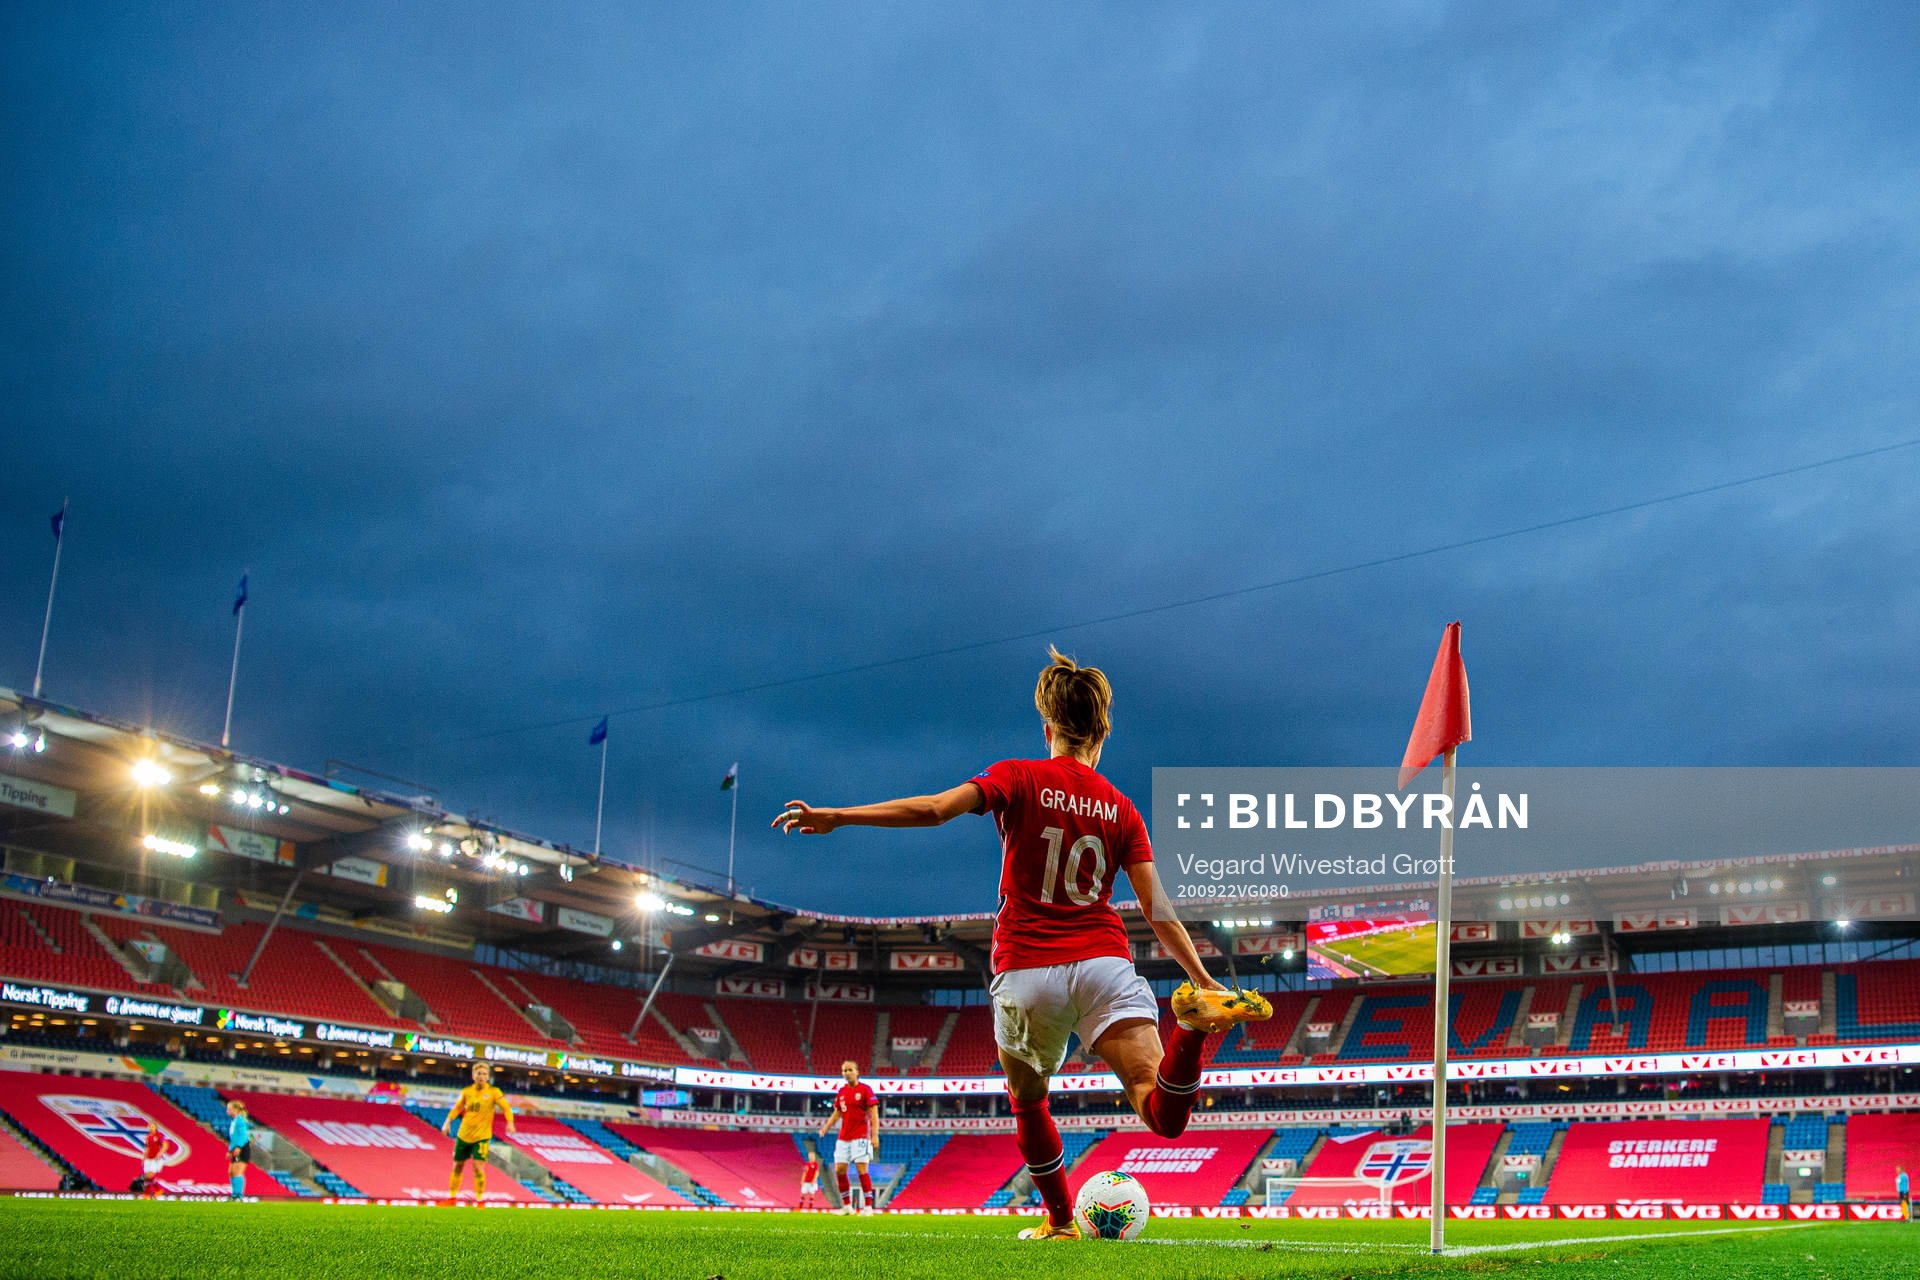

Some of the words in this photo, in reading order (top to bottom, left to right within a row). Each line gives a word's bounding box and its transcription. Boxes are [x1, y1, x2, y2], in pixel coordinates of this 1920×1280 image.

[1040, 787, 1118, 824] GRAHAM
[1040, 825, 1107, 907] 10
[1727, 903, 1801, 924] VG
[1830, 896, 1906, 917] VG
[1524, 918, 1594, 937] VG
[1621, 910, 1690, 930] VG
[702, 942, 758, 960] VG
[1238, 935, 1299, 953] VG
[897, 953, 959, 968] VG
[1451, 960, 1519, 977] VG
[1544, 953, 1614, 972] VG
[720, 978, 782, 996] VG
[808, 984, 871, 1000] VG
[2, 984, 42, 1005] Norsk
[41, 988, 89, 1013] Tipping
[235, 1014, 267, 1032] Norsk
[266, 1017, 304, 1038] Tipping
[697, 1073, 733, 1084] VG
[751, 1077, 794, 1088] VG
[879, 1081, 924, 1091] VG
[943, 1081, 985, 1091] VG
[1062, 1077, 1105, 1089] VG
[1251, 1070, 1297, 1083] VG
[1318, 1068, 1366, 1081] VG
[1387, 1066, 1434, 1079] VG
[1457, 1063, 1508, 1077] VG
[1530, 1060, 1582, 1074] VG
[1604, 1057, 1658, 1071] VG
[1681, 1055, 1736, 1069] VG
[1760, 1052, 1817, 1067] VG
[1841, 1049, 1899, 1063] VG
[914, 1119, 946, 1128] VG
[950, 1119, 981, 1128] VG
[985, 1118, 1014, 1127] VG
[1086, 1116, 1116, 1125] VG
[1191, 1112, 1222, 1122] VG
[1227, 1111, 1259, 1121] VG
[1264, 1111, 1296, 1121] VG
[1302, 1109, 1335, 1120] VG
[1340, 1109, 1373, 1119] VG
[1458, 1107, 1493, 1117] VG
[1500, 1106, 1534, 1116] VG
[1540, 1104, 1576, 1115] VG
[1583, 1103, 1619, 1114] VG
[1625, 1102, 1662, 1113] VG
[1668, 1101, 1706, 1112] VG
[1712, 1100, 1751, 1110] VG
[1757, 1099, 1796, 1109] VG
[1803, 1097, 1842, 1108] VG
[1849, 1096, 1889, 1107] VG
[1124, 1147, 1219, 1160] STERKERE
[1608, 1139, 1718, 1154] STERKERE
[1117, 1160, 1203, 1173] SAMMEN
[1609, 1153, 1709, 1168] SAMMEN
[972, 1208, 1010, 1217] VG
[1151, 1206, 1193, 1218] VG
[1199, 1206, 1241, 1218] VG
[1248, 1206, 1290, 1218] VG
[1297, 1206, 1339, 1218] VG
[1346, 1206, 1391, 1218] VG
[1451, 1206, 1496, 1219] VG
[1504, 1205, 1550, 1219] VG
[1559, 1205, 1606, 1219] VG
[1615, 1205, 1664, 1219] VG
[1671, 1204, 1721, 1219] VG
[1729, 1204, 1780, 1219] VG
[1788, 1204, 1841, 1219] VG
[1849, 1204, 1902, 1219] VG
